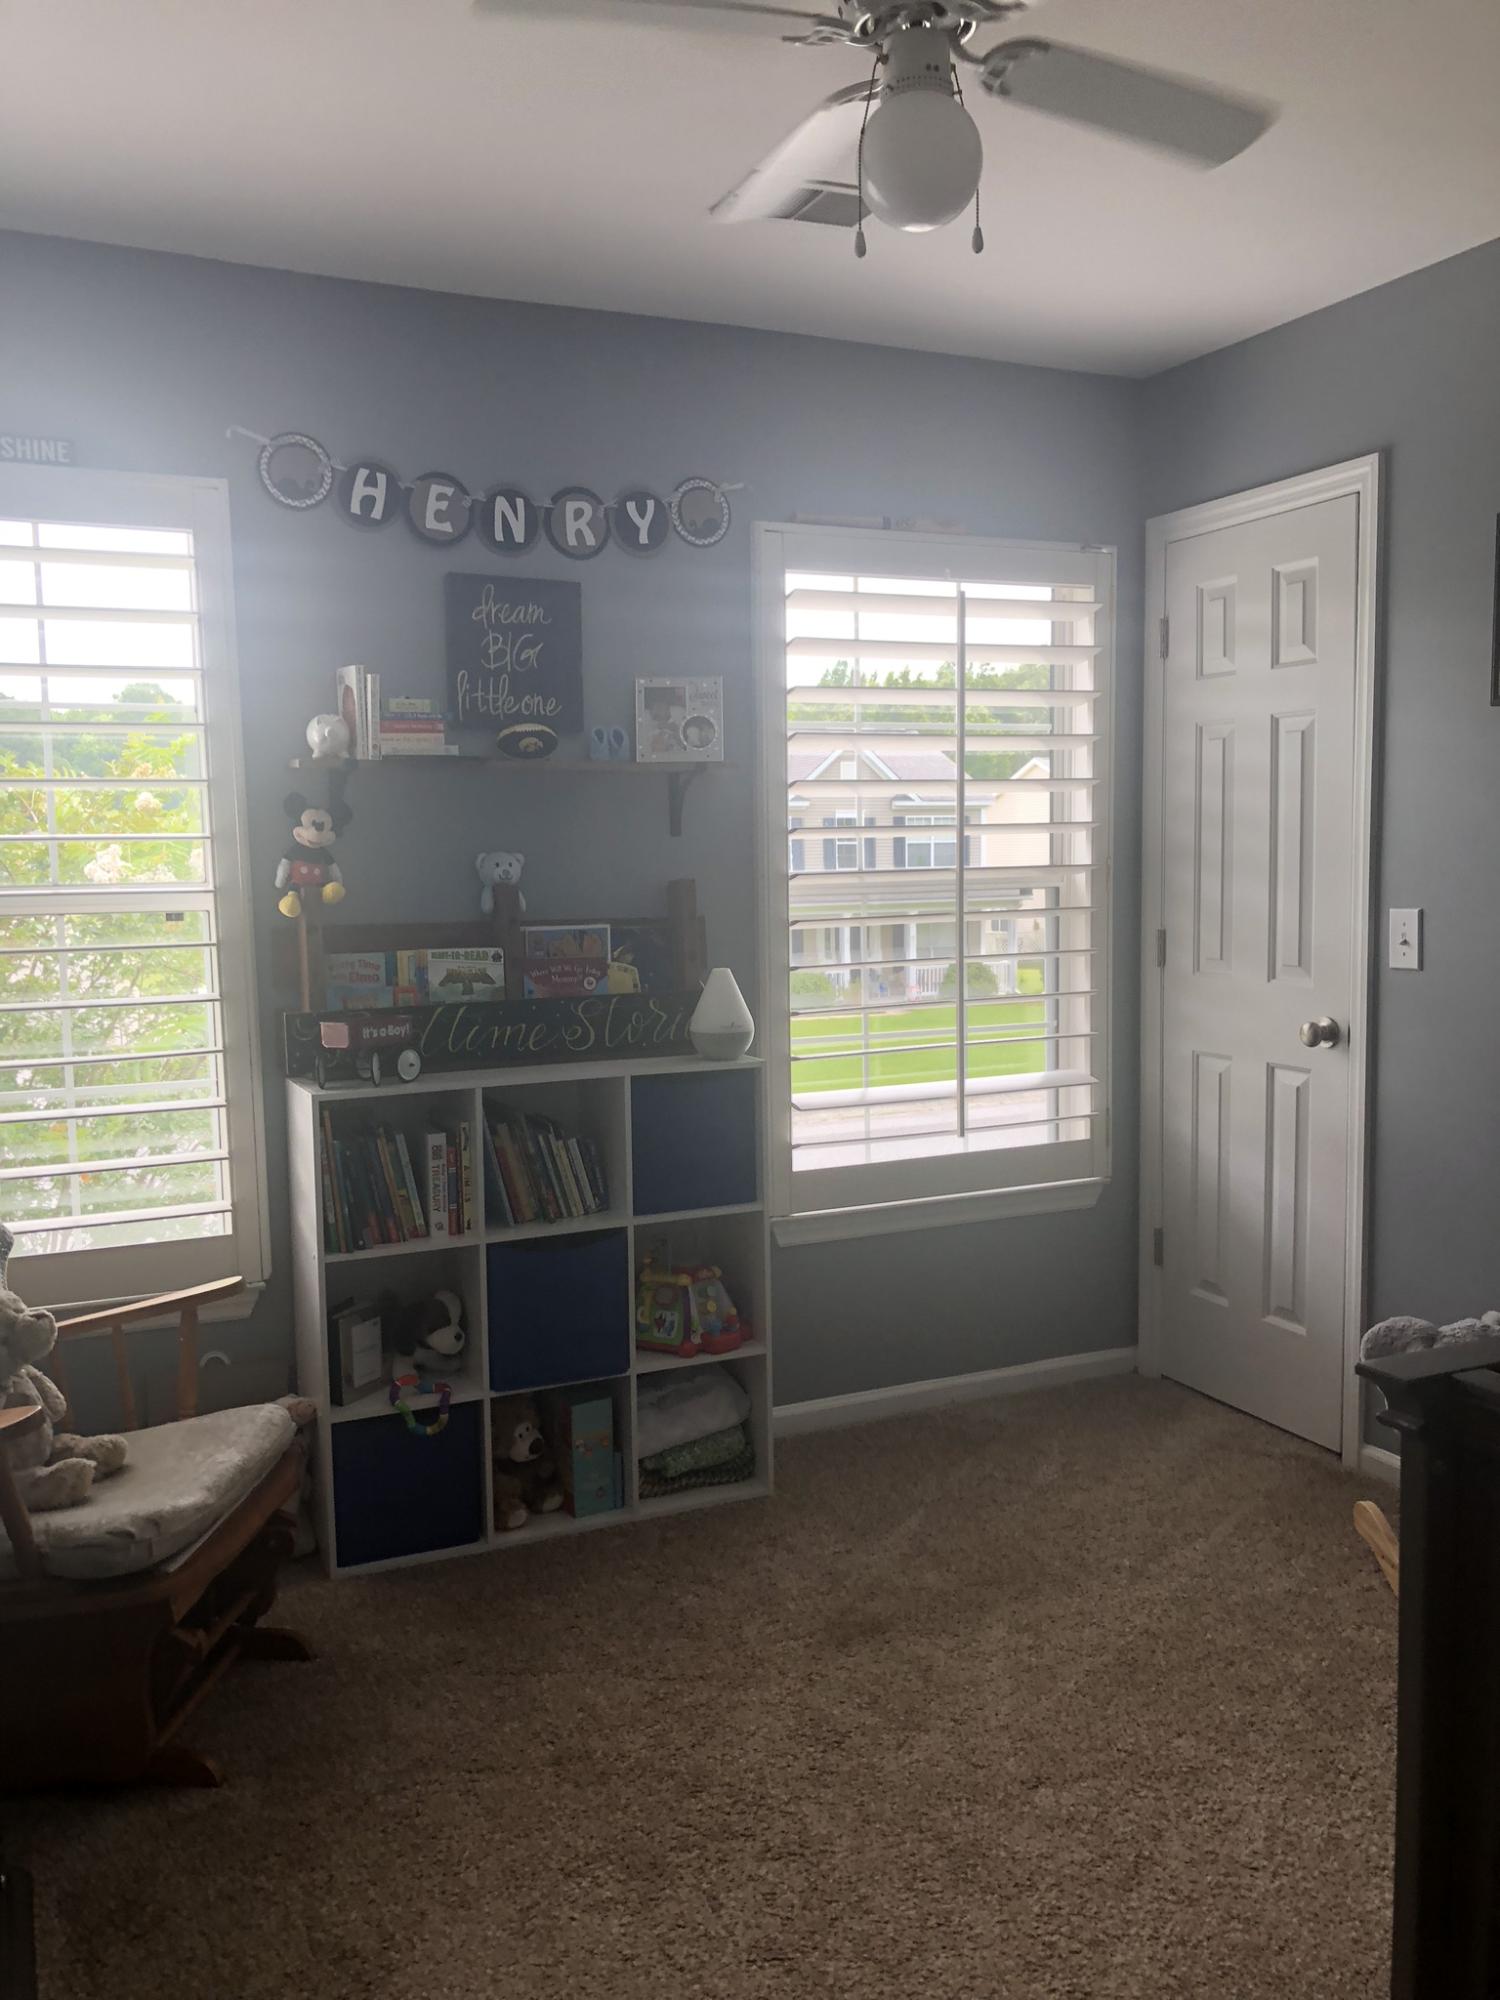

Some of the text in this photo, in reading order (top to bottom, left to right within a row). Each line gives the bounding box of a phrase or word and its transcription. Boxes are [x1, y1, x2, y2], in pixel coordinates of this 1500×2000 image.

[0, 436, 71, 463] SHINE
[350, 467, 655, 546] HENRY
[471, 583, 553, 629] dream
[480, 630, 544, 672] BIG
[362, 1023, 411, 1039] It's a Boy!
[562, 995, 691, 1051] Stori
